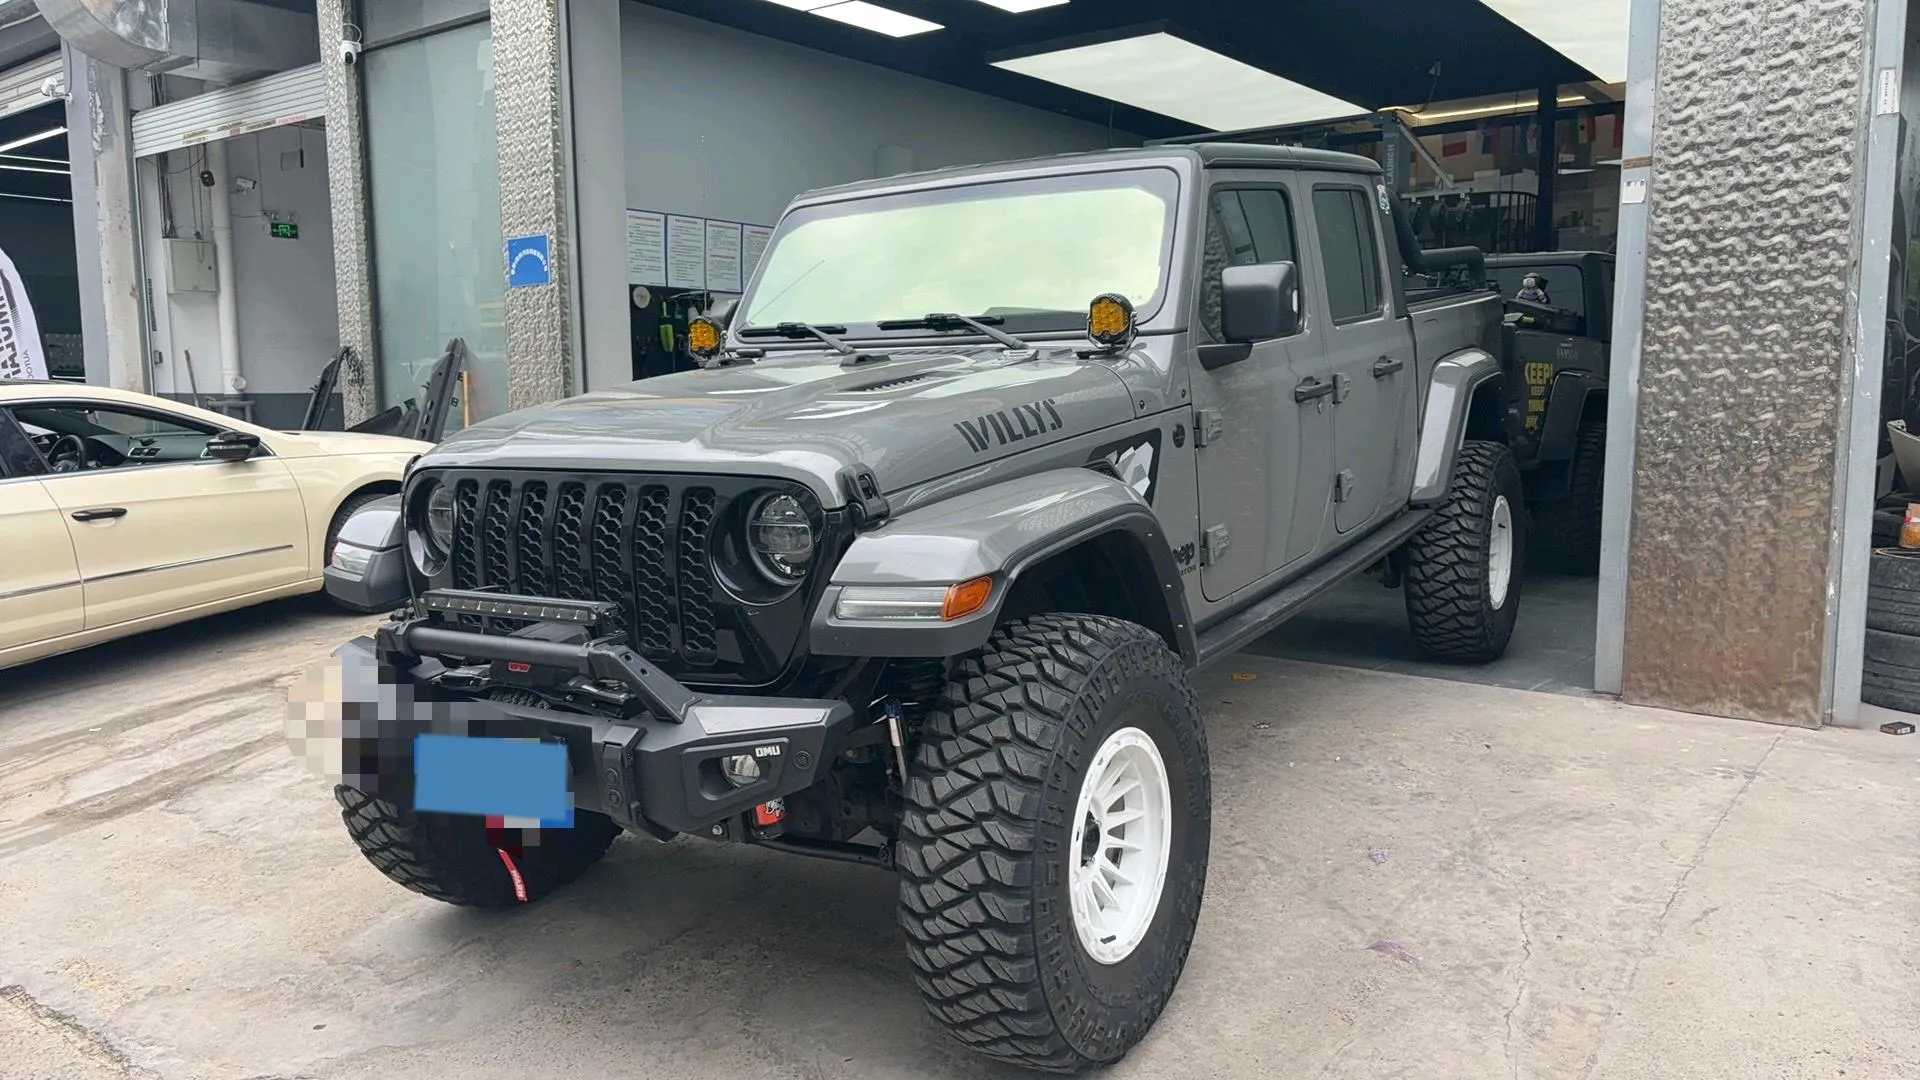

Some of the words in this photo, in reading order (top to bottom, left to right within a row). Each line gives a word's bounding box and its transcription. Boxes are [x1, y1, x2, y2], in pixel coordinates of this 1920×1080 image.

[1387, 144, 1395, 185] LAUNCH
[953, 398, 1063, 453] WILLYS
[755, 745, 781, 757] OMU
